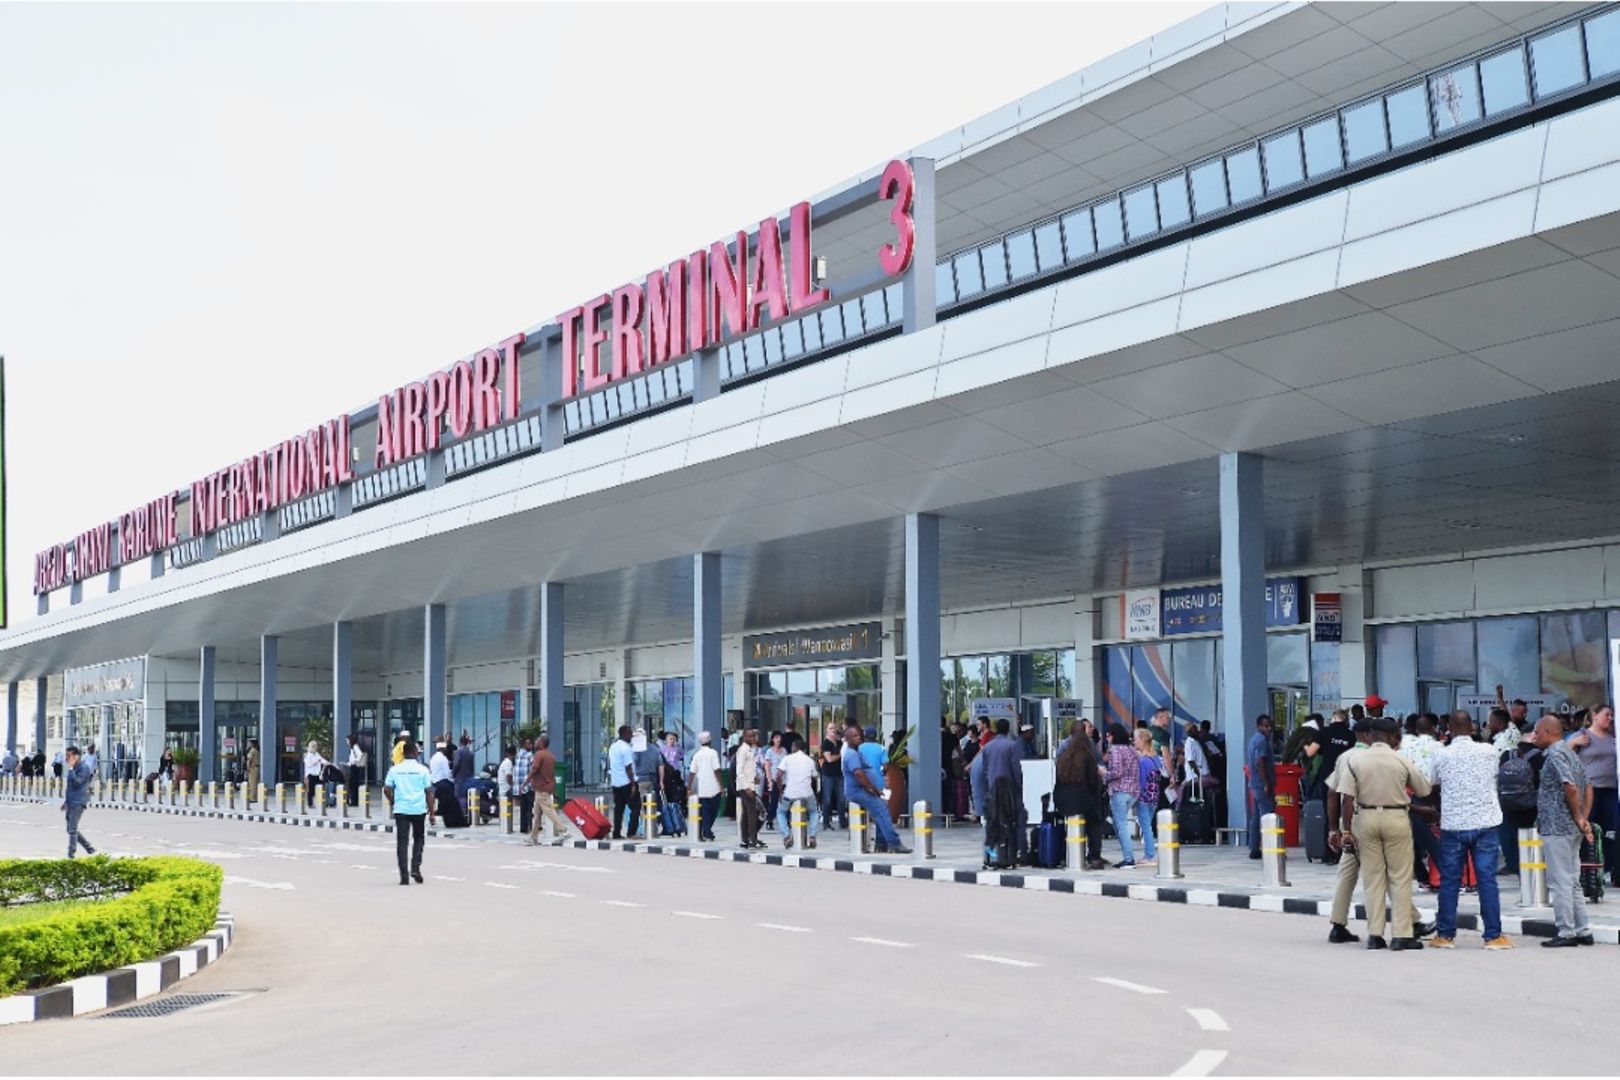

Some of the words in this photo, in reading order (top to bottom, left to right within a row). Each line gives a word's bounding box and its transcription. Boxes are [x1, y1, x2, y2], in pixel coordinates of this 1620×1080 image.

[72, 521, 112, 582] AMANI
[117, 490, 180, 565] KARUME
[188, 413, 356, 538] INTERNATIONAL
[374, 332, 526, 470] AIRPORT
[555, 200, 831, 399] TERMINAL
[878, 158, 917, 277] 3
[1164, 594, 1204, 611] BUREAU
[1208, 592, 1223, 608] DE
[861, 628, 869, 649] 1
